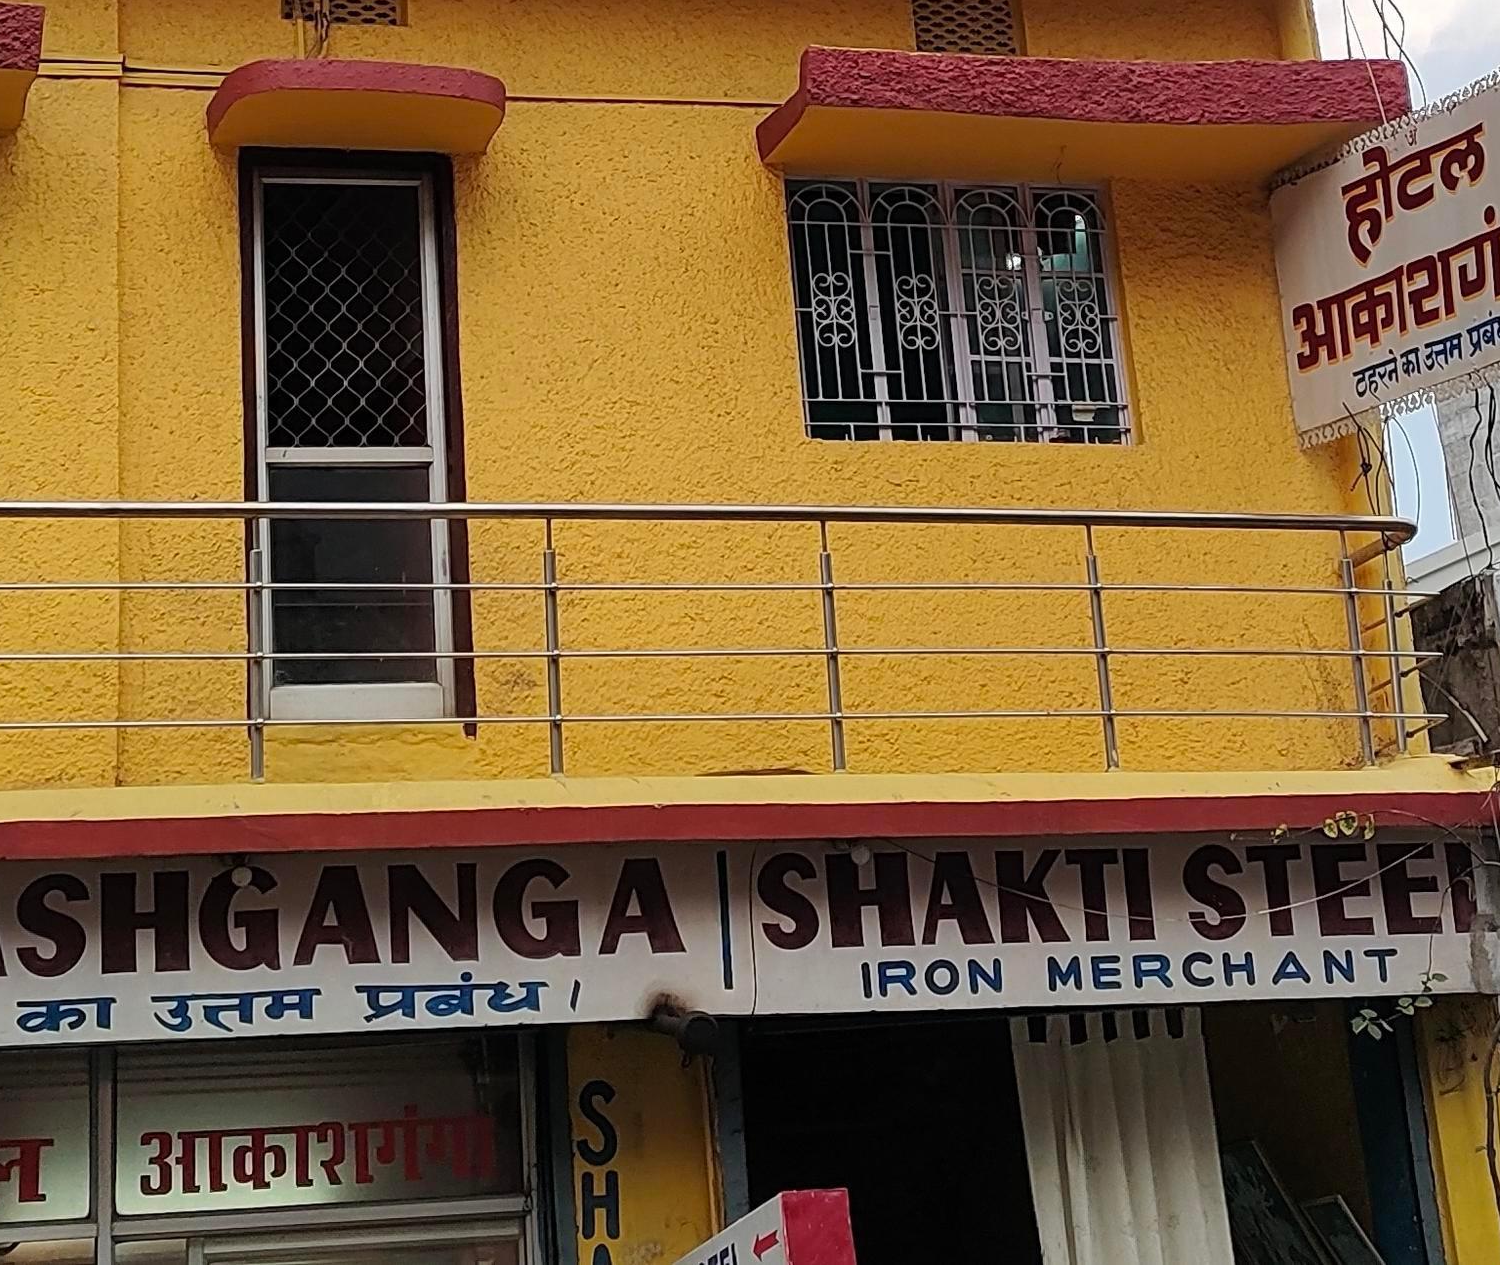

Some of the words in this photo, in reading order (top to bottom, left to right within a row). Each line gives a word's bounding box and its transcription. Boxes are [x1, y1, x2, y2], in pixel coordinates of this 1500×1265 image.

[1341, 122, 1486, 268] होटल
[1353, 347, 1400, 401] ठहरने
[1401, 350, 1423, 378] का
[757, 848, 1157, 950] SHAKTI
[17, 996, 117, 1033] का
[151, 987, 322, 1033] उत्तम
[861, 958, 1003, 1000] IRON
[1049, 948, 1399, 992] MERCHANT
[140, 1104, 497, 1196] आकाशगंगा
